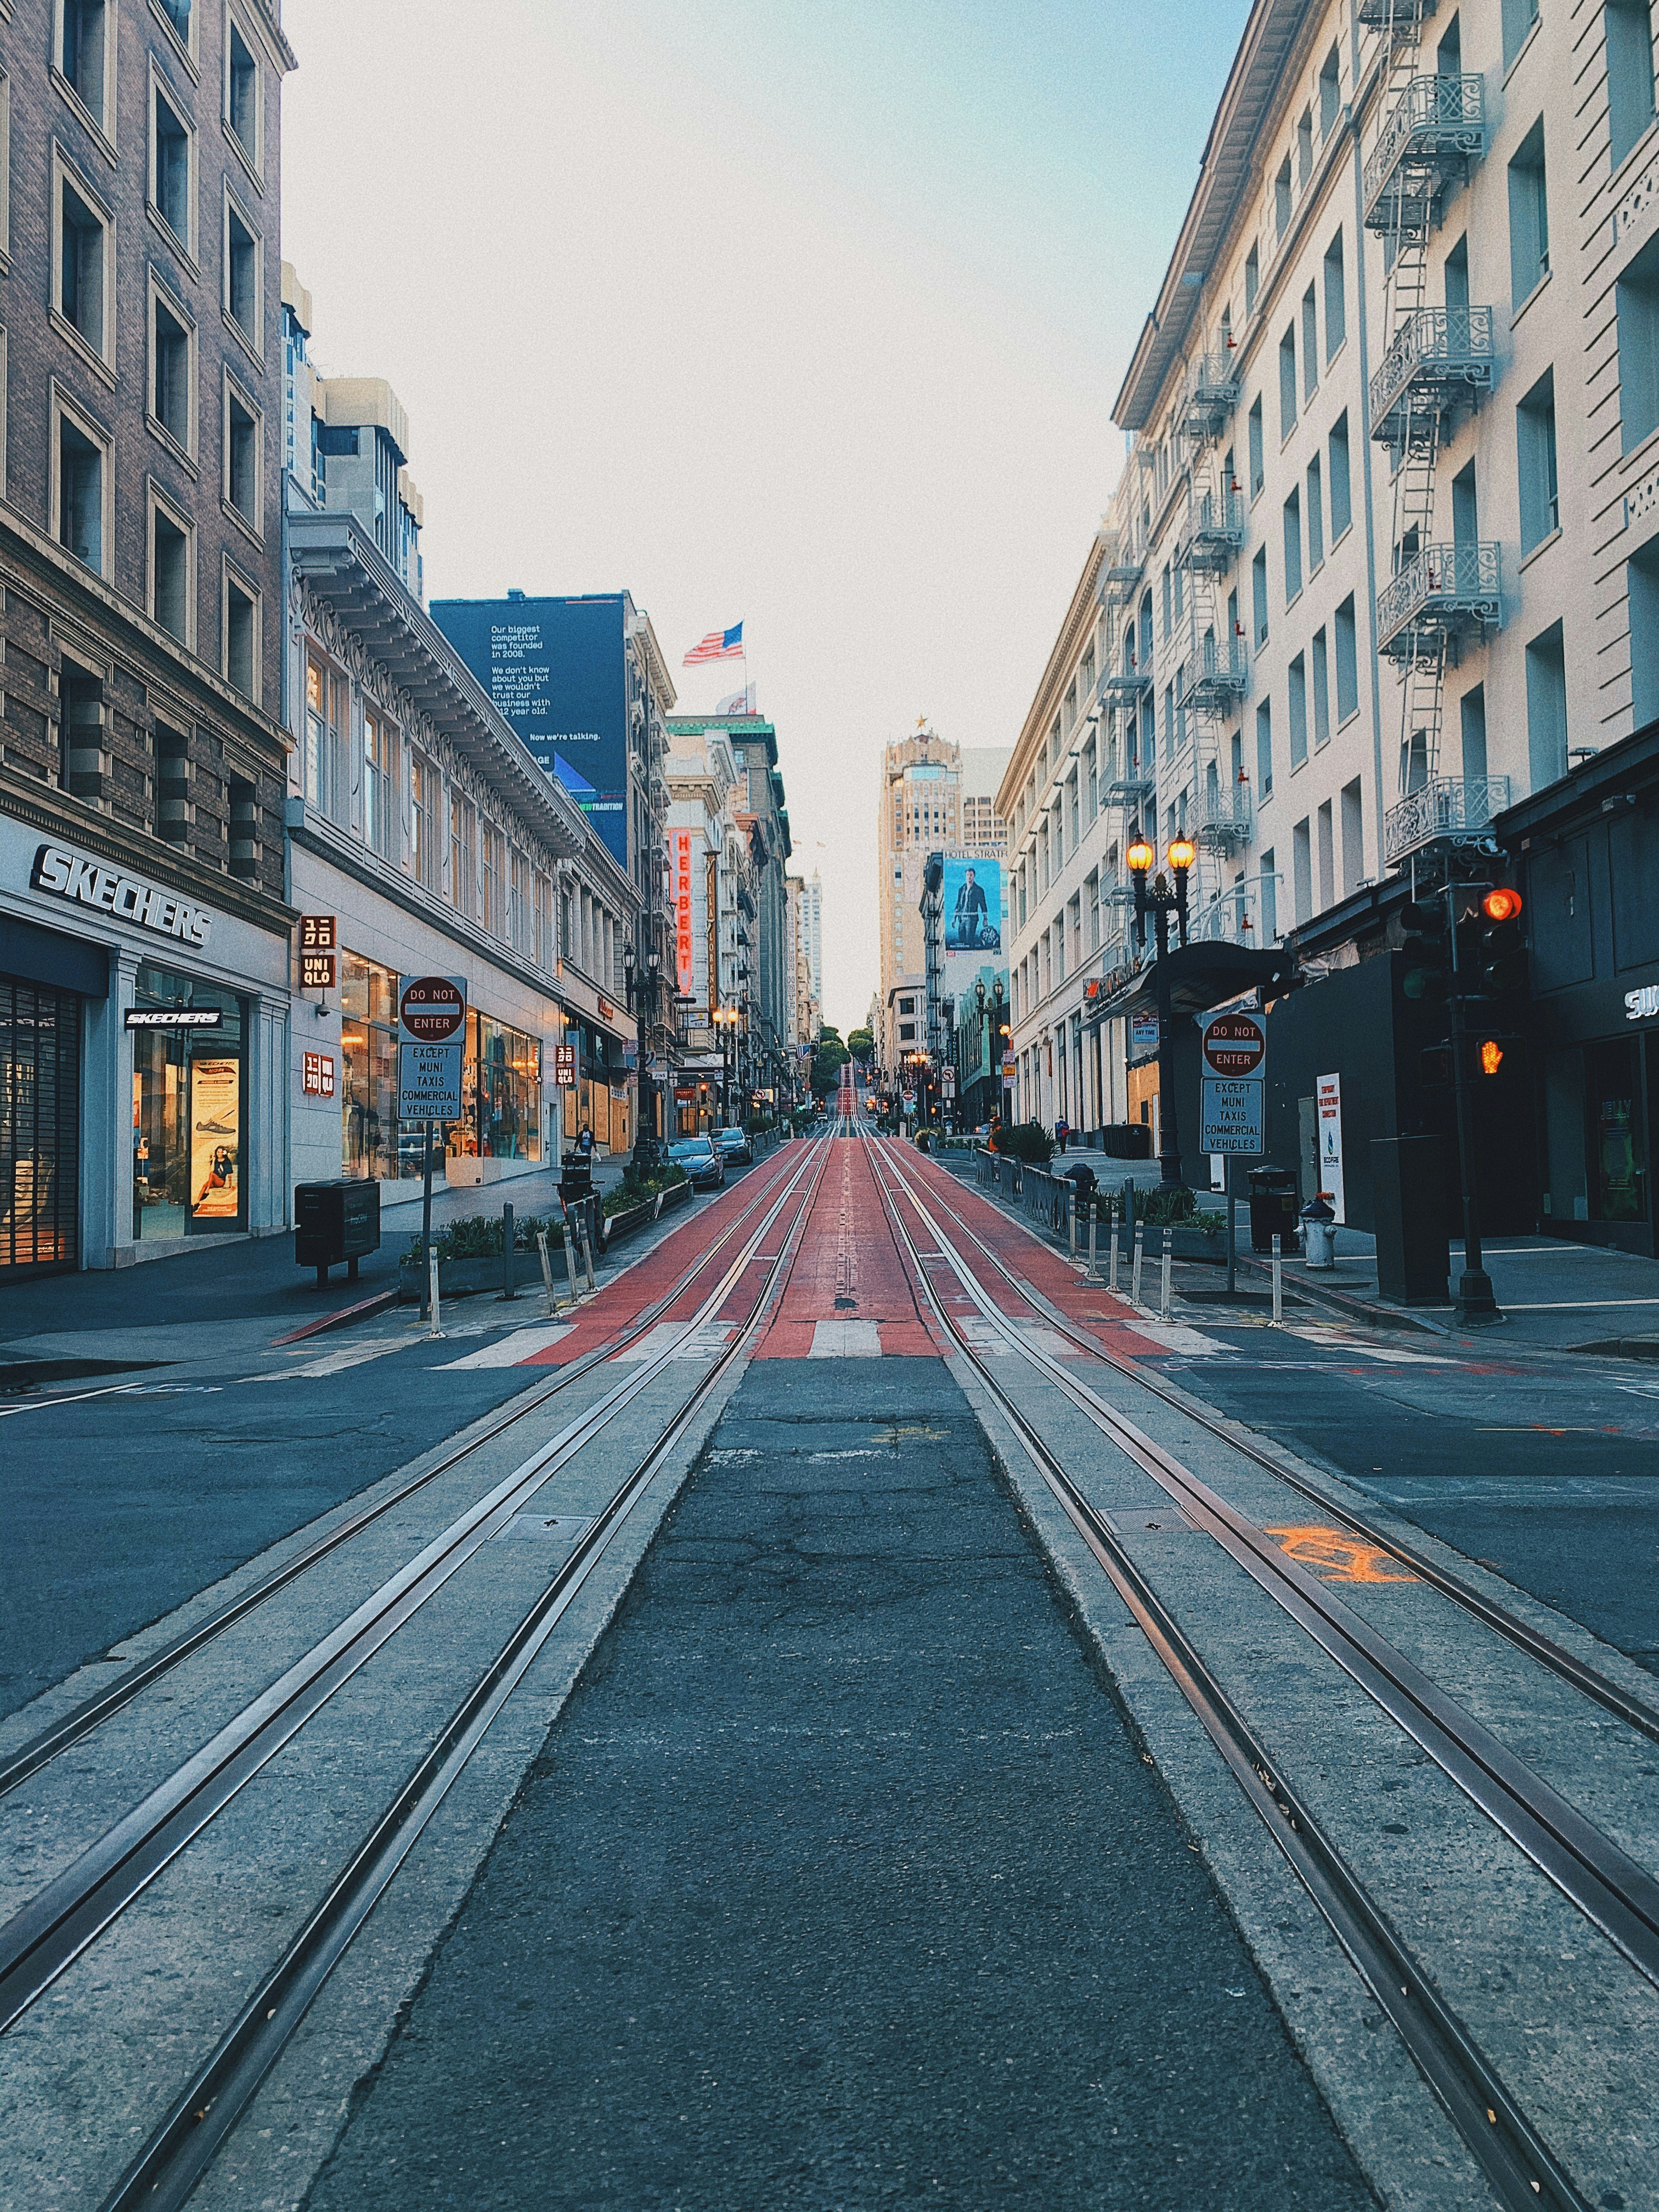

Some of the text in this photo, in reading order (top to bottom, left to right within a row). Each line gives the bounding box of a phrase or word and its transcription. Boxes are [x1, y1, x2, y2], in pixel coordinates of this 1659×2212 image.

[491, 625, 540, 634] Our biggest
[491, 634, 538, 642] competitor
[509, 641, 543, 650] founded
[503, 650, 525, 658] 2008.
[492, 666, 504, 674] We
[505, 666, 527, 674] don't
[505, 682, 540, 690] wouldn't
[493, 698, 551, 707] business with
[511, 708, 530, 716] year
[532, 707, 548, 715] old.
[546, 732, 567, 741] we're
[569, 732, 601, 741] talking.
[945, 850, 972, 859] HOTEL
[706, 858, 715, 917] VILLA
[39, 848, 213, 946] SKECHERS
[679, 836, 689, 969] HERBERT
[304, 958, 328, 970] UNI
[304, 971, 330, 985] QLO
[410, 990, 455, 1000] DO NOT
[787, 975, 795, 1018] HOTEL
[1624, 985, 1659, 1020] SW
[126, 1013, 219, 1024] SKECHERS
[414, 1018, 450, 1029] ENTER
[1213, 1026, 1256, 1037] DO NOT
[413, 1047, 450, 1058] EXCEPT
[1216, 1054, 1251, 1065] ENTER
[419, 1062, 443, 1073] MUNI
[417, 1076, 444, 1087] TAXIS
[558, 1076, 573, 1084] QLO
[1215, 1082, 1251, 1093] EXCEPT
[402, 1090, 458, 1101] COMMERCIAL
[1221, 1097, 1244, 1107] MUNI
[407, 1104, 453, 1116] VEHICLES
[1601, 1099, 1632, 1120] JELLY
[1220, 1111, 1246, 1121] TAXIS
[1205, 1124, 1260, 1136] COMMERCIAL
[1210, 1138, 1256, 1150] VEHICLES
